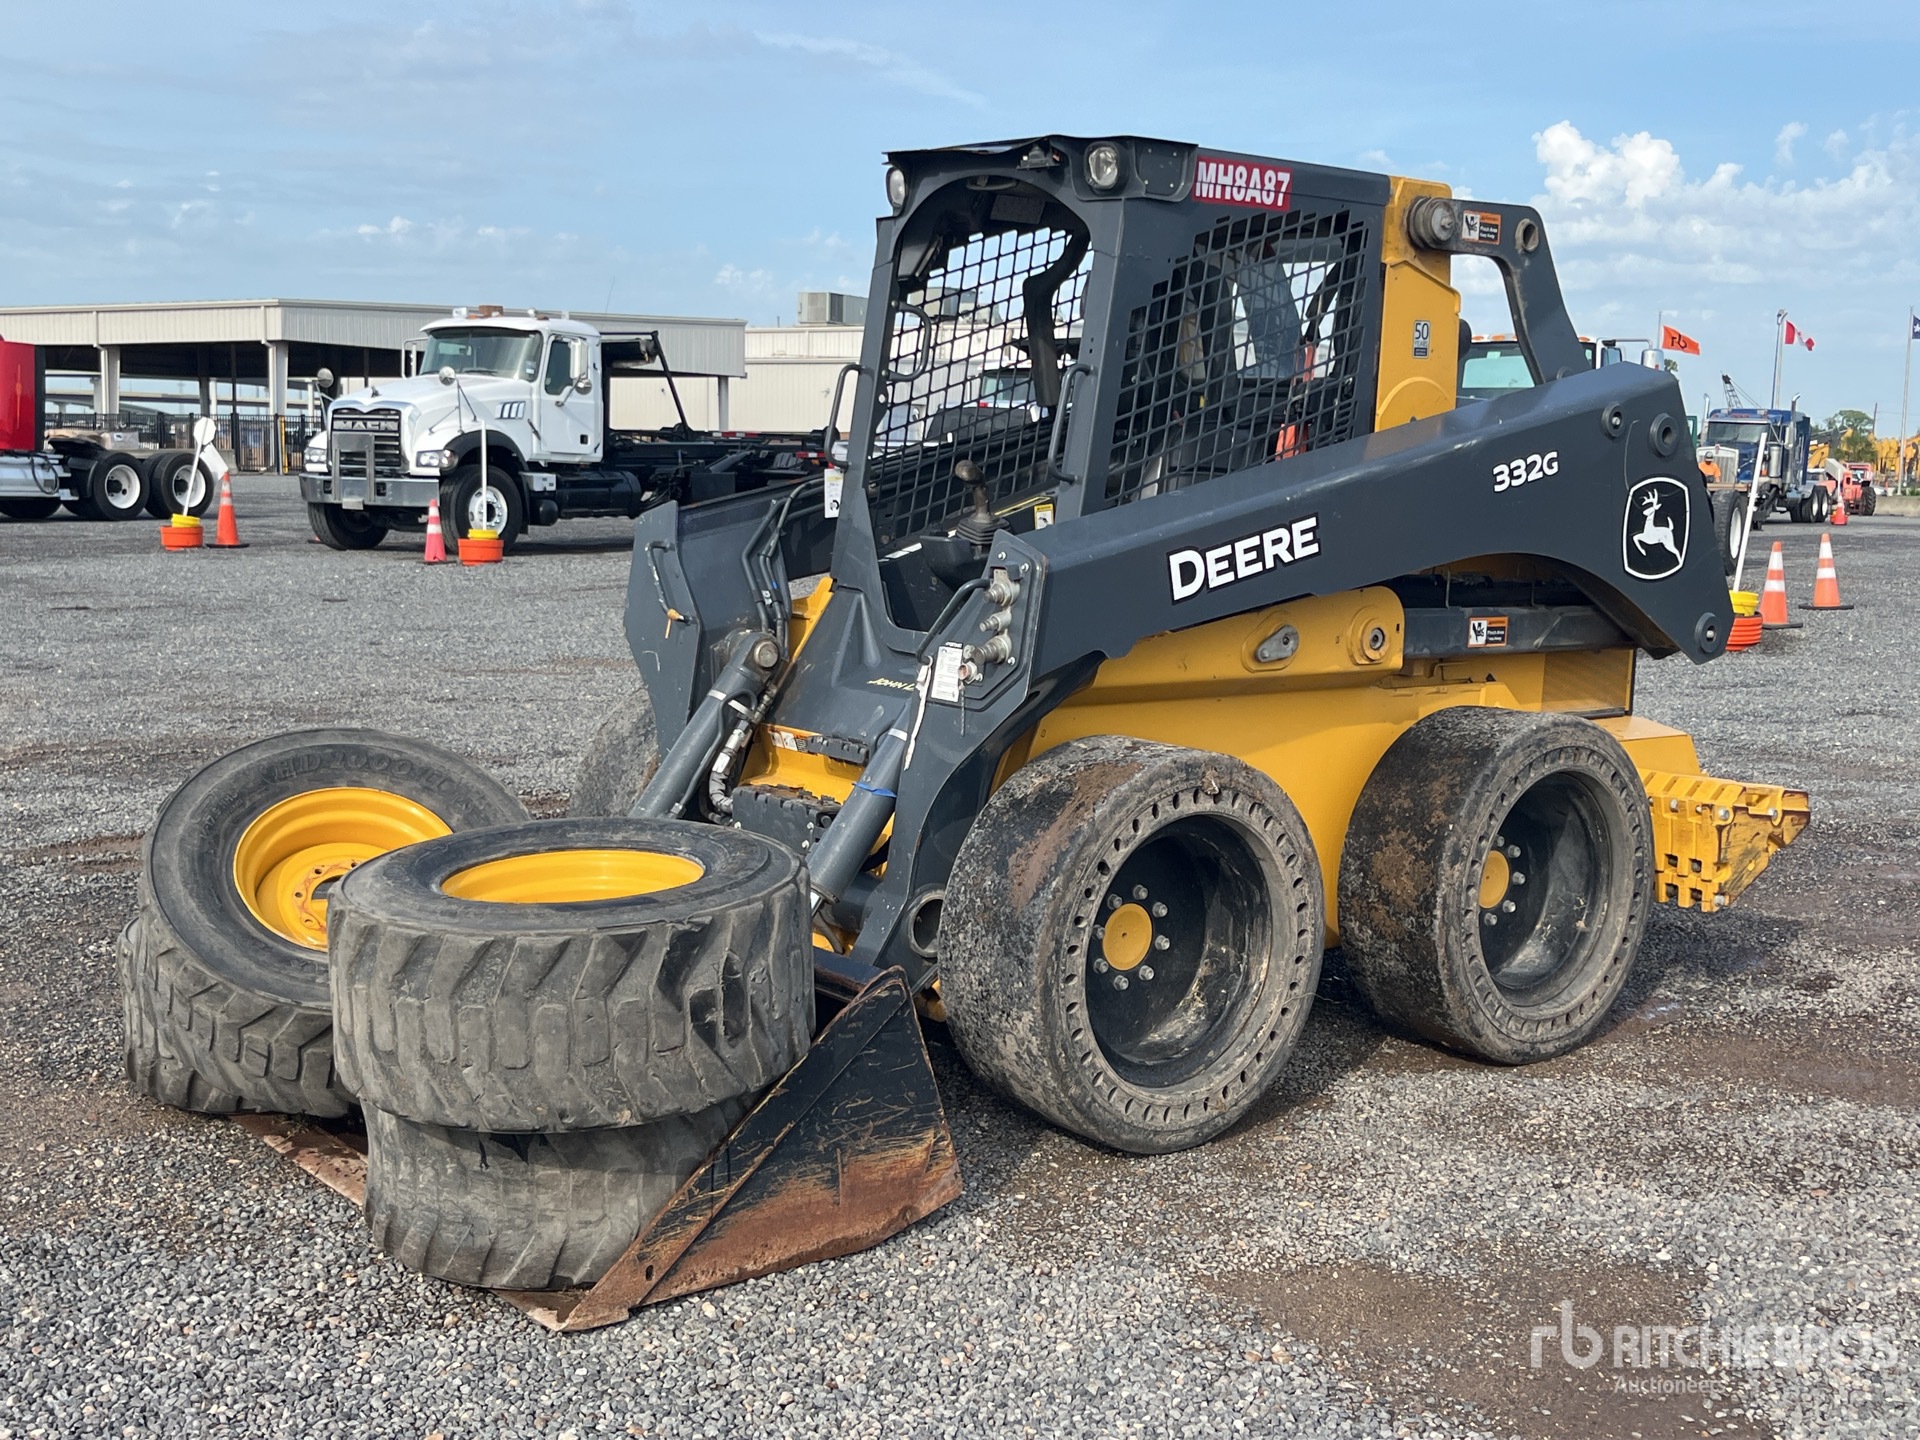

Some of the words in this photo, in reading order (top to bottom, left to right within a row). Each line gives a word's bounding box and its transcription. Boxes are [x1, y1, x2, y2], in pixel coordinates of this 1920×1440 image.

[1195, 161, 1291, 207] MH8A87
[1415, 322, 1429, 340] 50
[333, 420, 399, 431] MACK
[1493, 451, 1559, 492] 332G
[1169, 516, 1320, 601] DEERE
